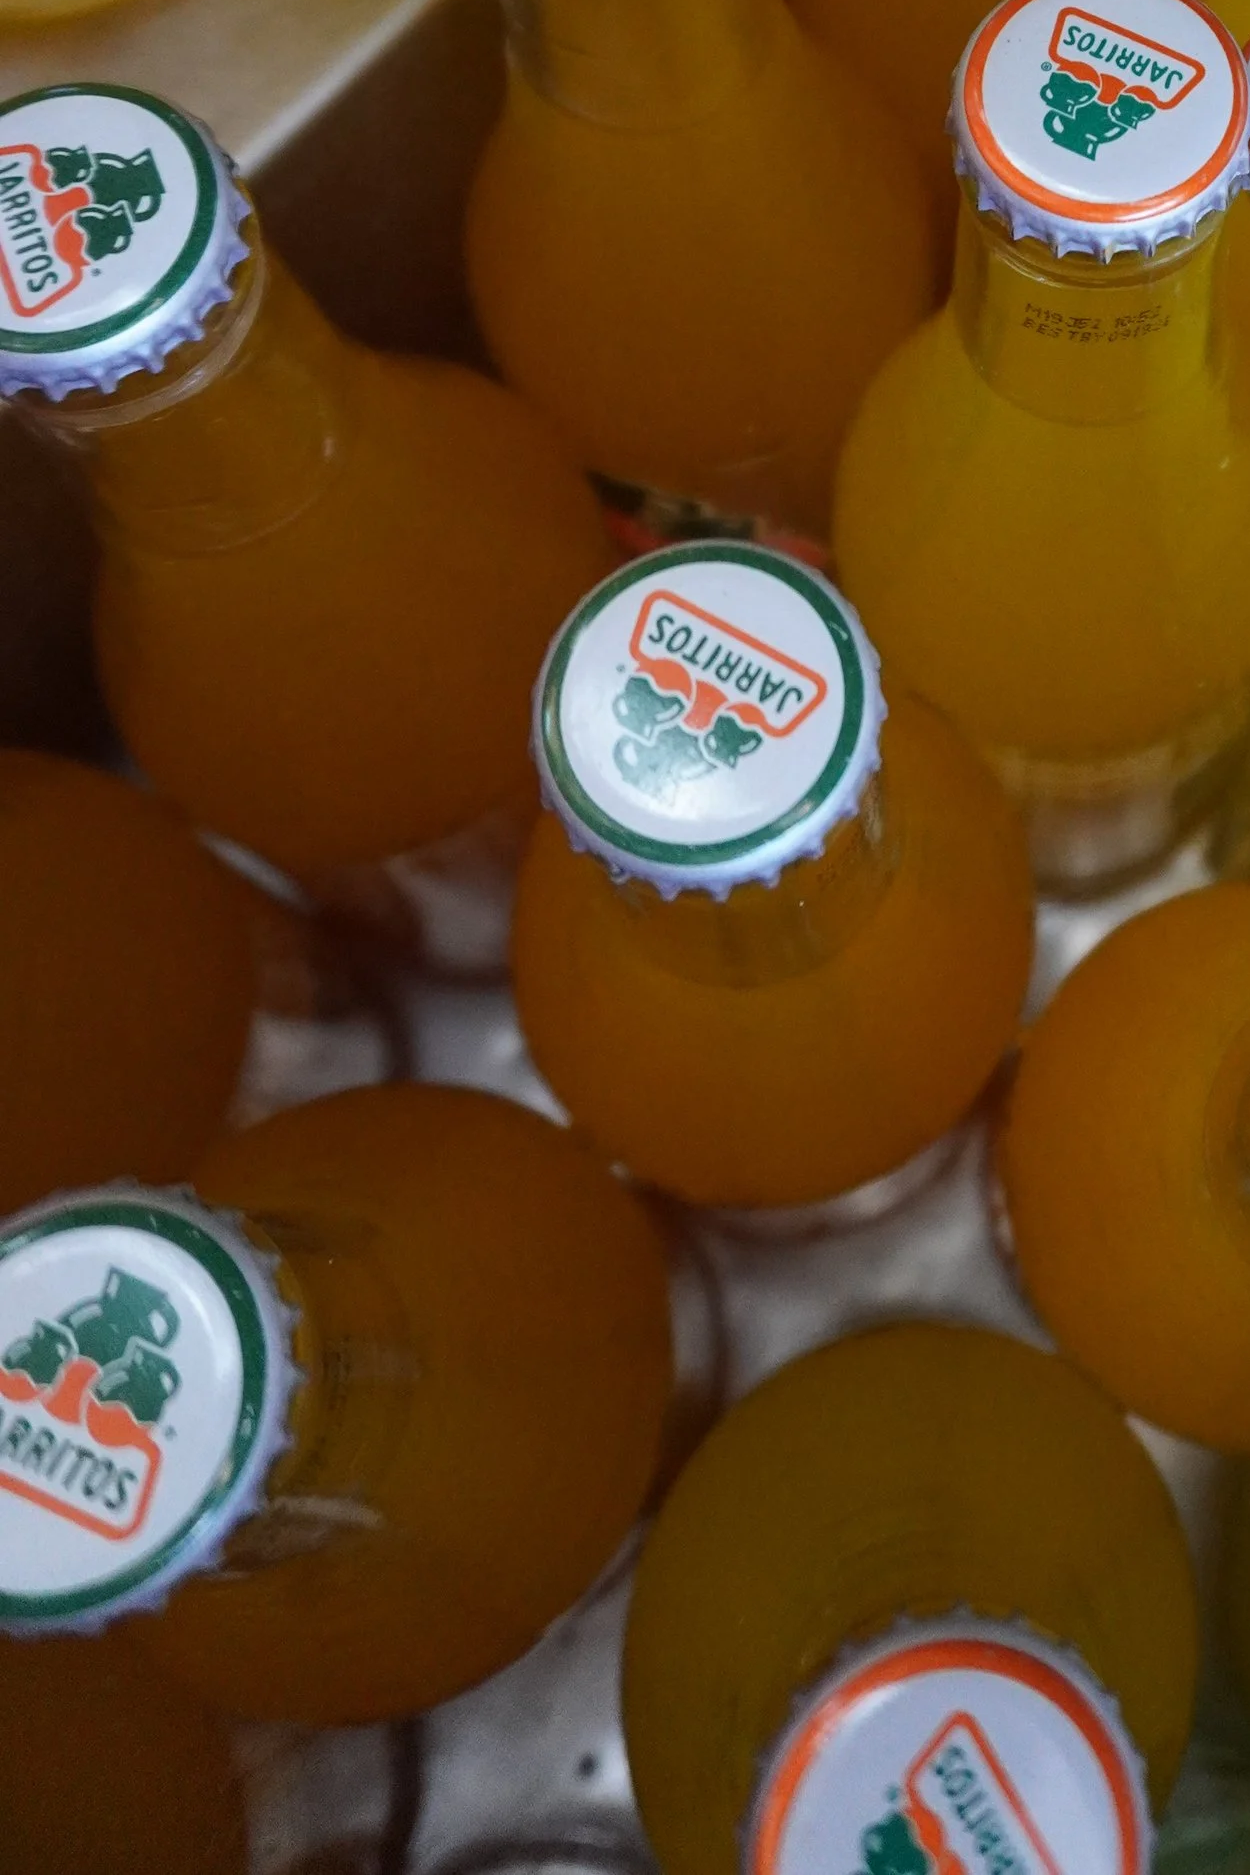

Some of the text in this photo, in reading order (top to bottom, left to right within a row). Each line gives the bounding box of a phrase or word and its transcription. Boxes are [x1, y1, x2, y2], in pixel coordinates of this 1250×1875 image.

[1063, 25, 1184, 90] JARRITOS
[648, 612, 804, 714] JARRITOS
[0, 1408, 139, 1512] RRITOS
